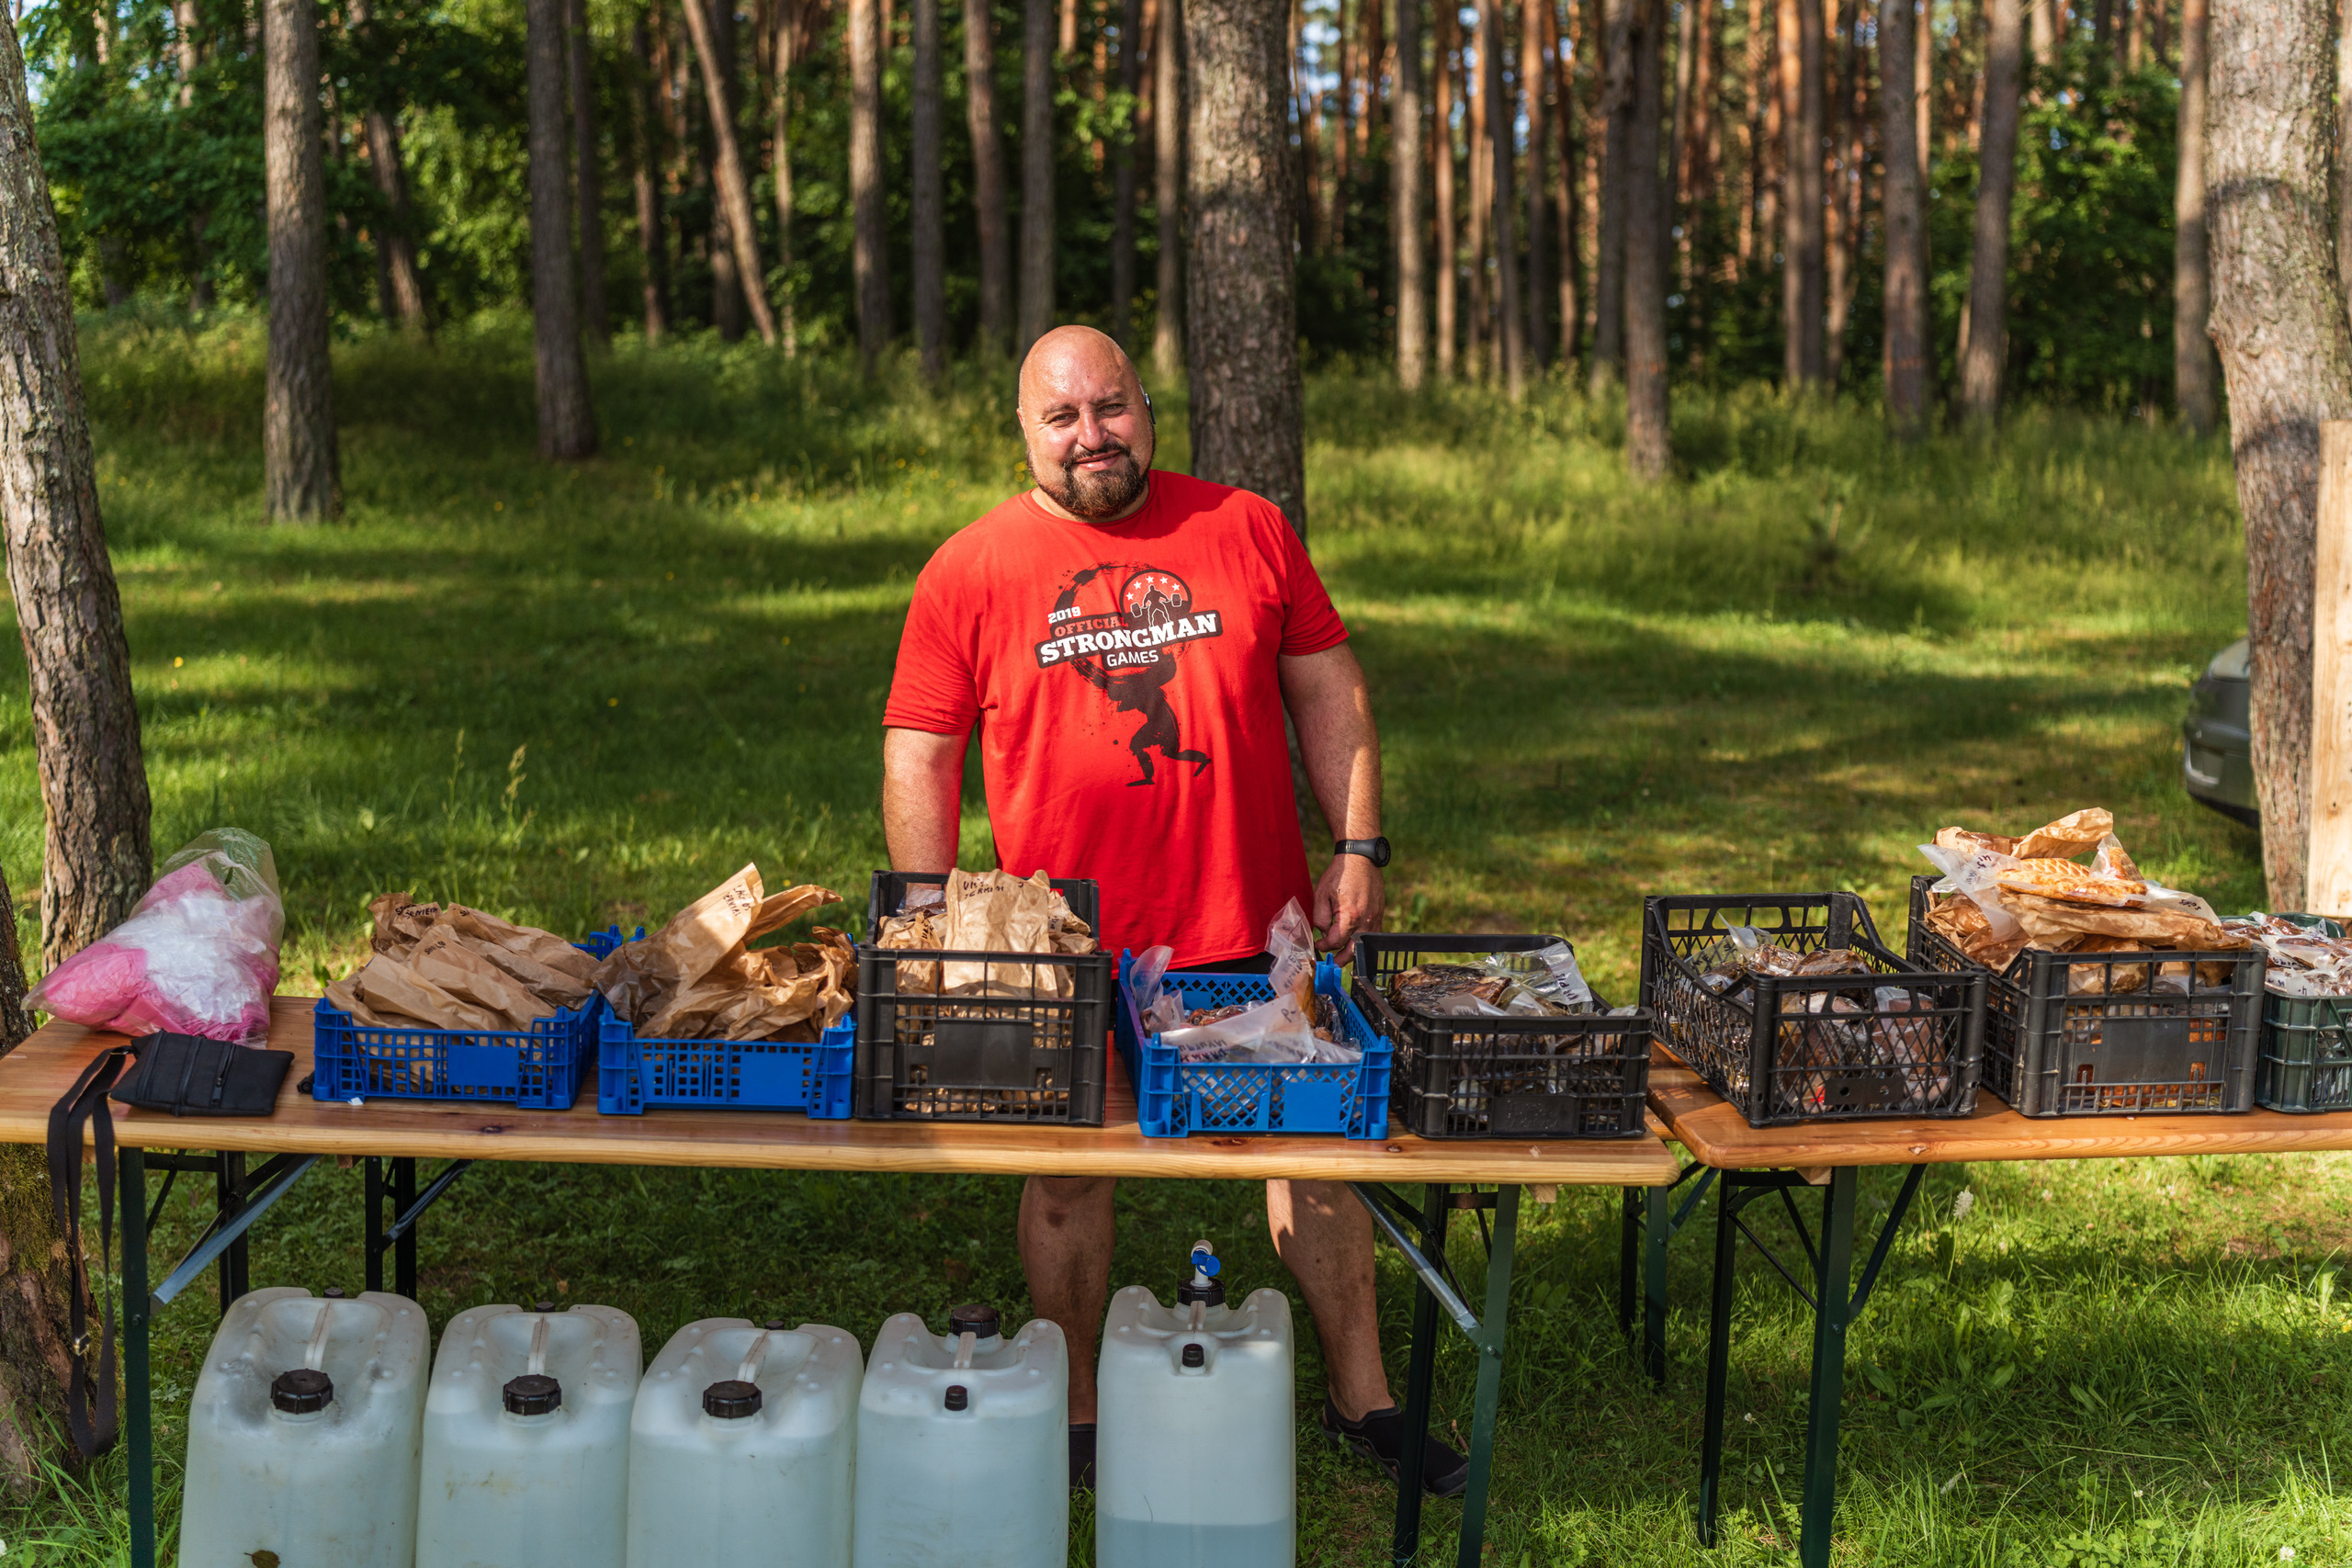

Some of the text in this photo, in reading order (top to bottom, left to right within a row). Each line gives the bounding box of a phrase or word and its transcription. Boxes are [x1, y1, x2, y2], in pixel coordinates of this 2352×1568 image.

[1047, 606, 1081, 624] 2019
[1055, 616, 1128, 637] OFFICIAL
[1040, 614, 1216, 664] STRONGMAN
[1106, 649, 1159, 667] GAMES
